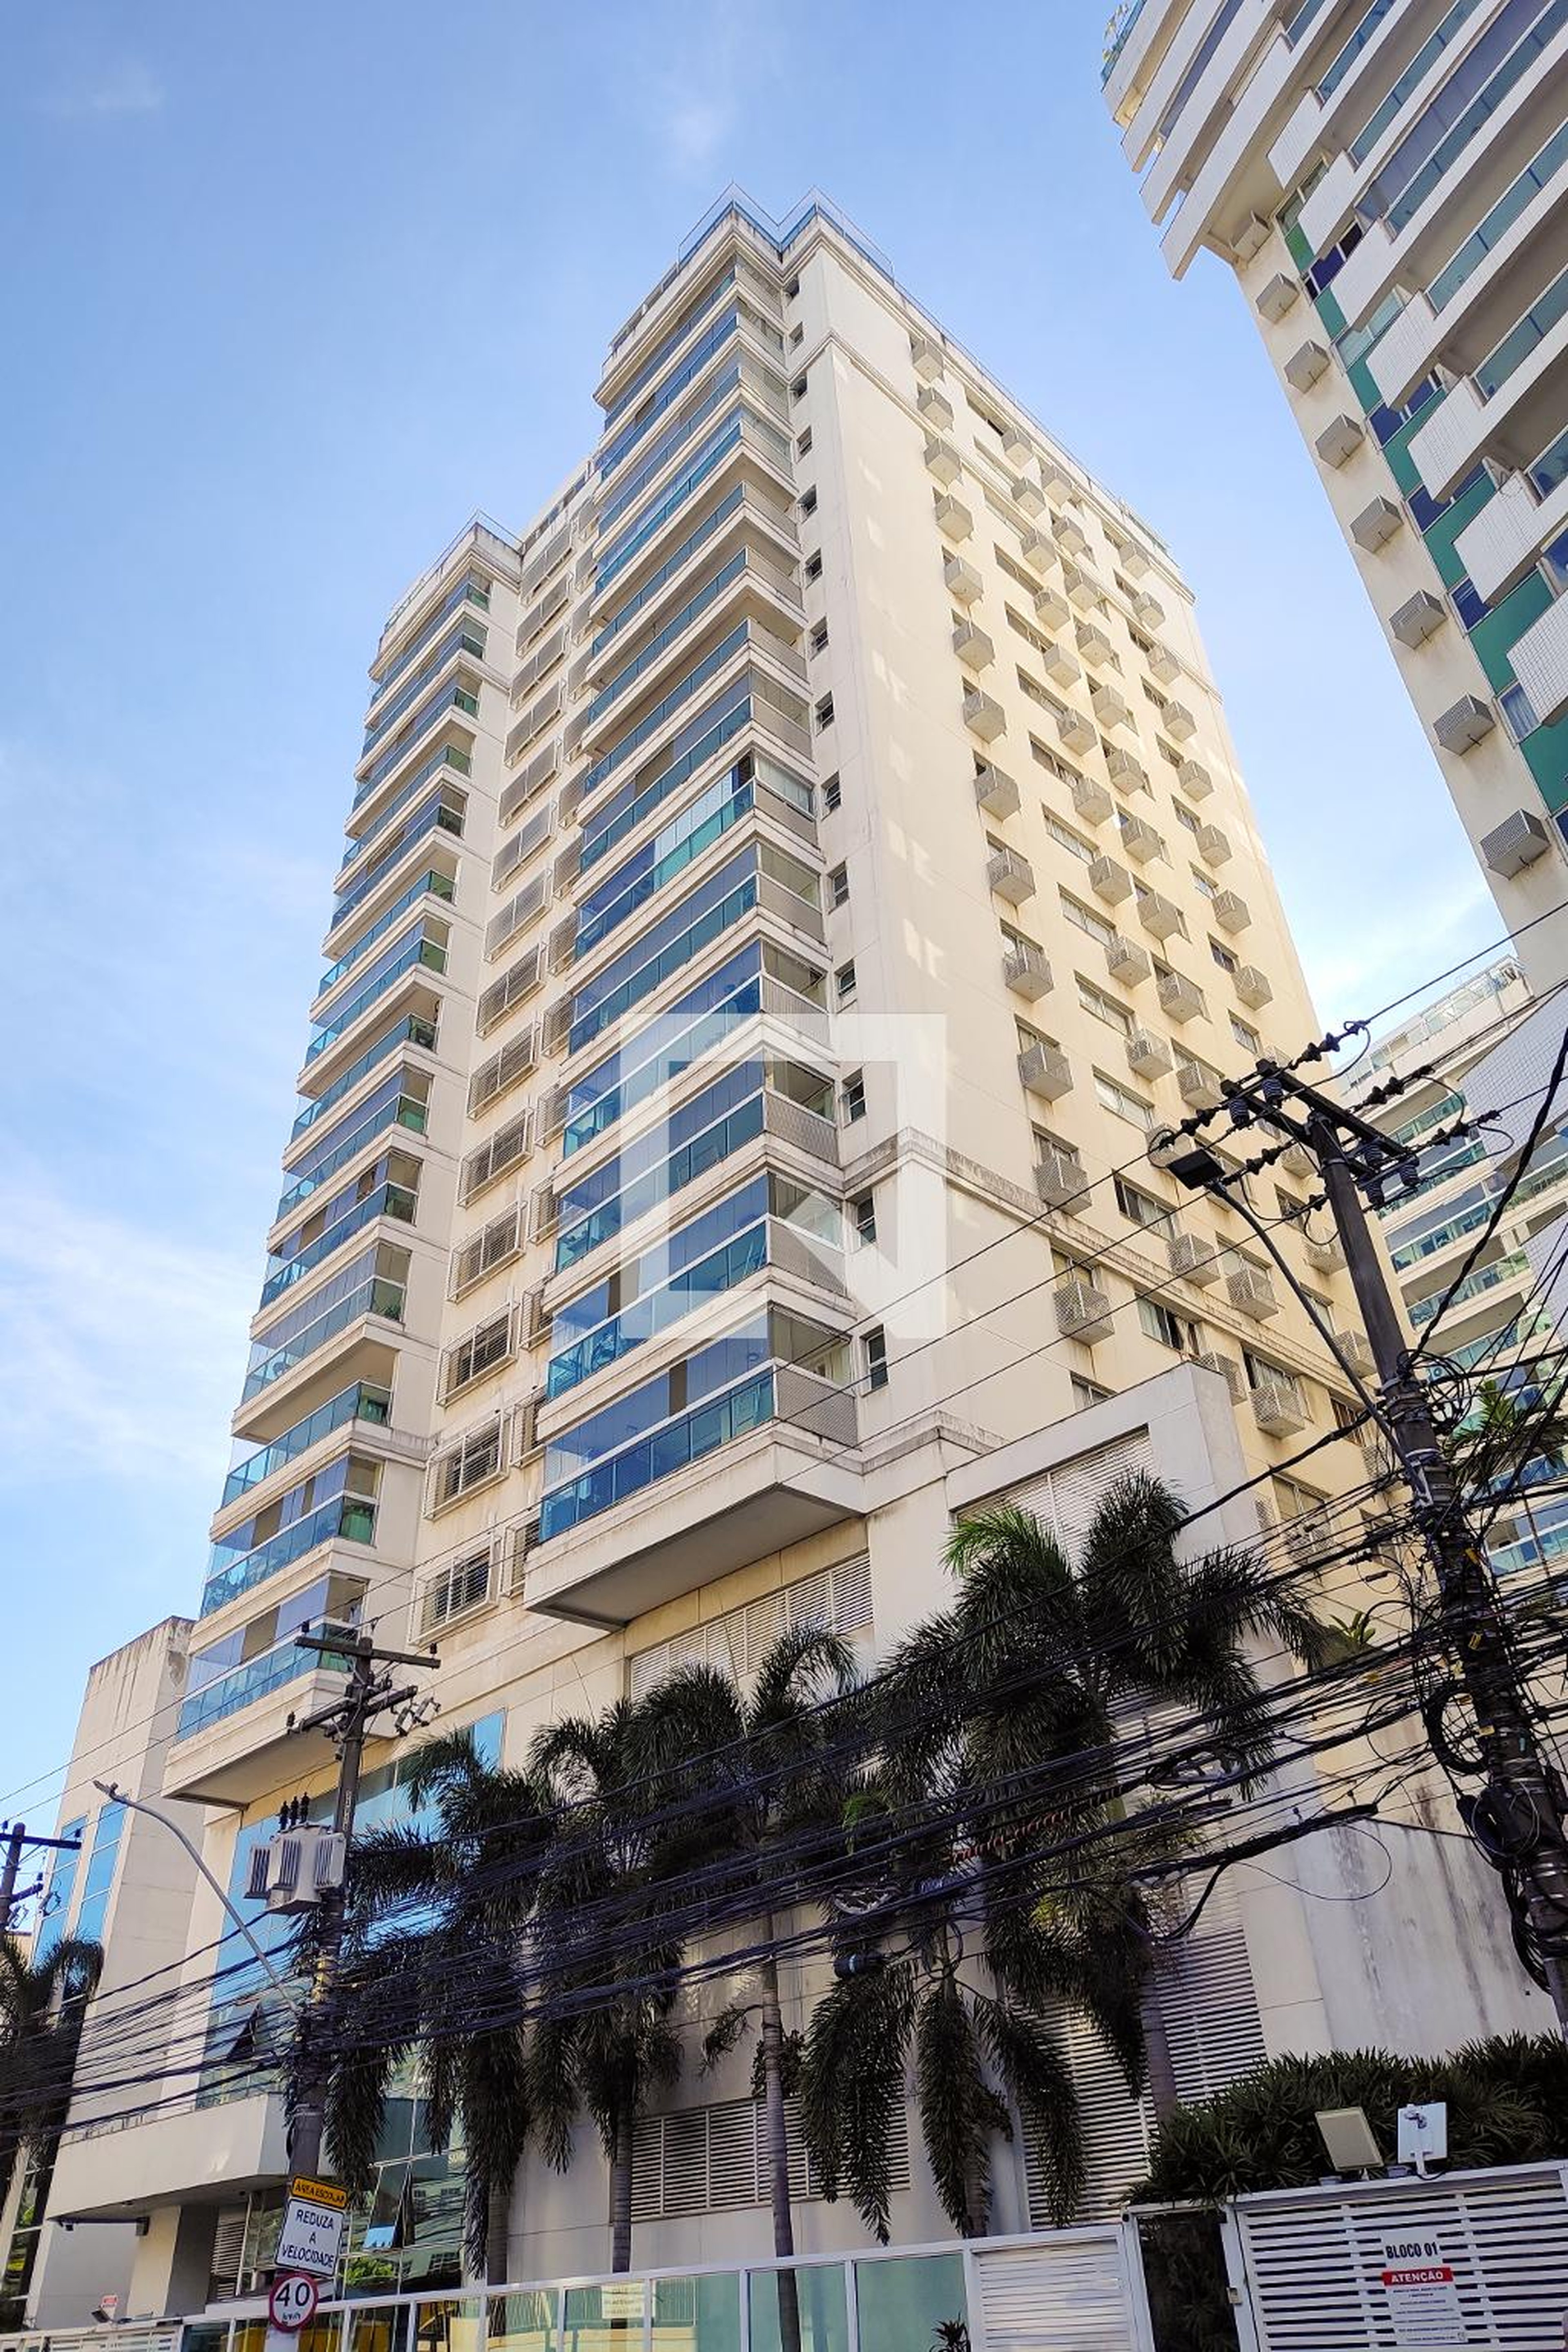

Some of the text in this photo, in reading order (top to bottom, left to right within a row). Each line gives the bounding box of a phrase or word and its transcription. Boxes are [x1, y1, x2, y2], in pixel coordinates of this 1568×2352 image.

[295, 2209, 334, 2230] REDUZA
[309, 2232, 316, 2244] A
[282, 2245, 334, 2268] VELOCIDADE
[1385, 2241, 1438, 2259] BLOCO 01
[275, 2283, 310, 2307] 40
